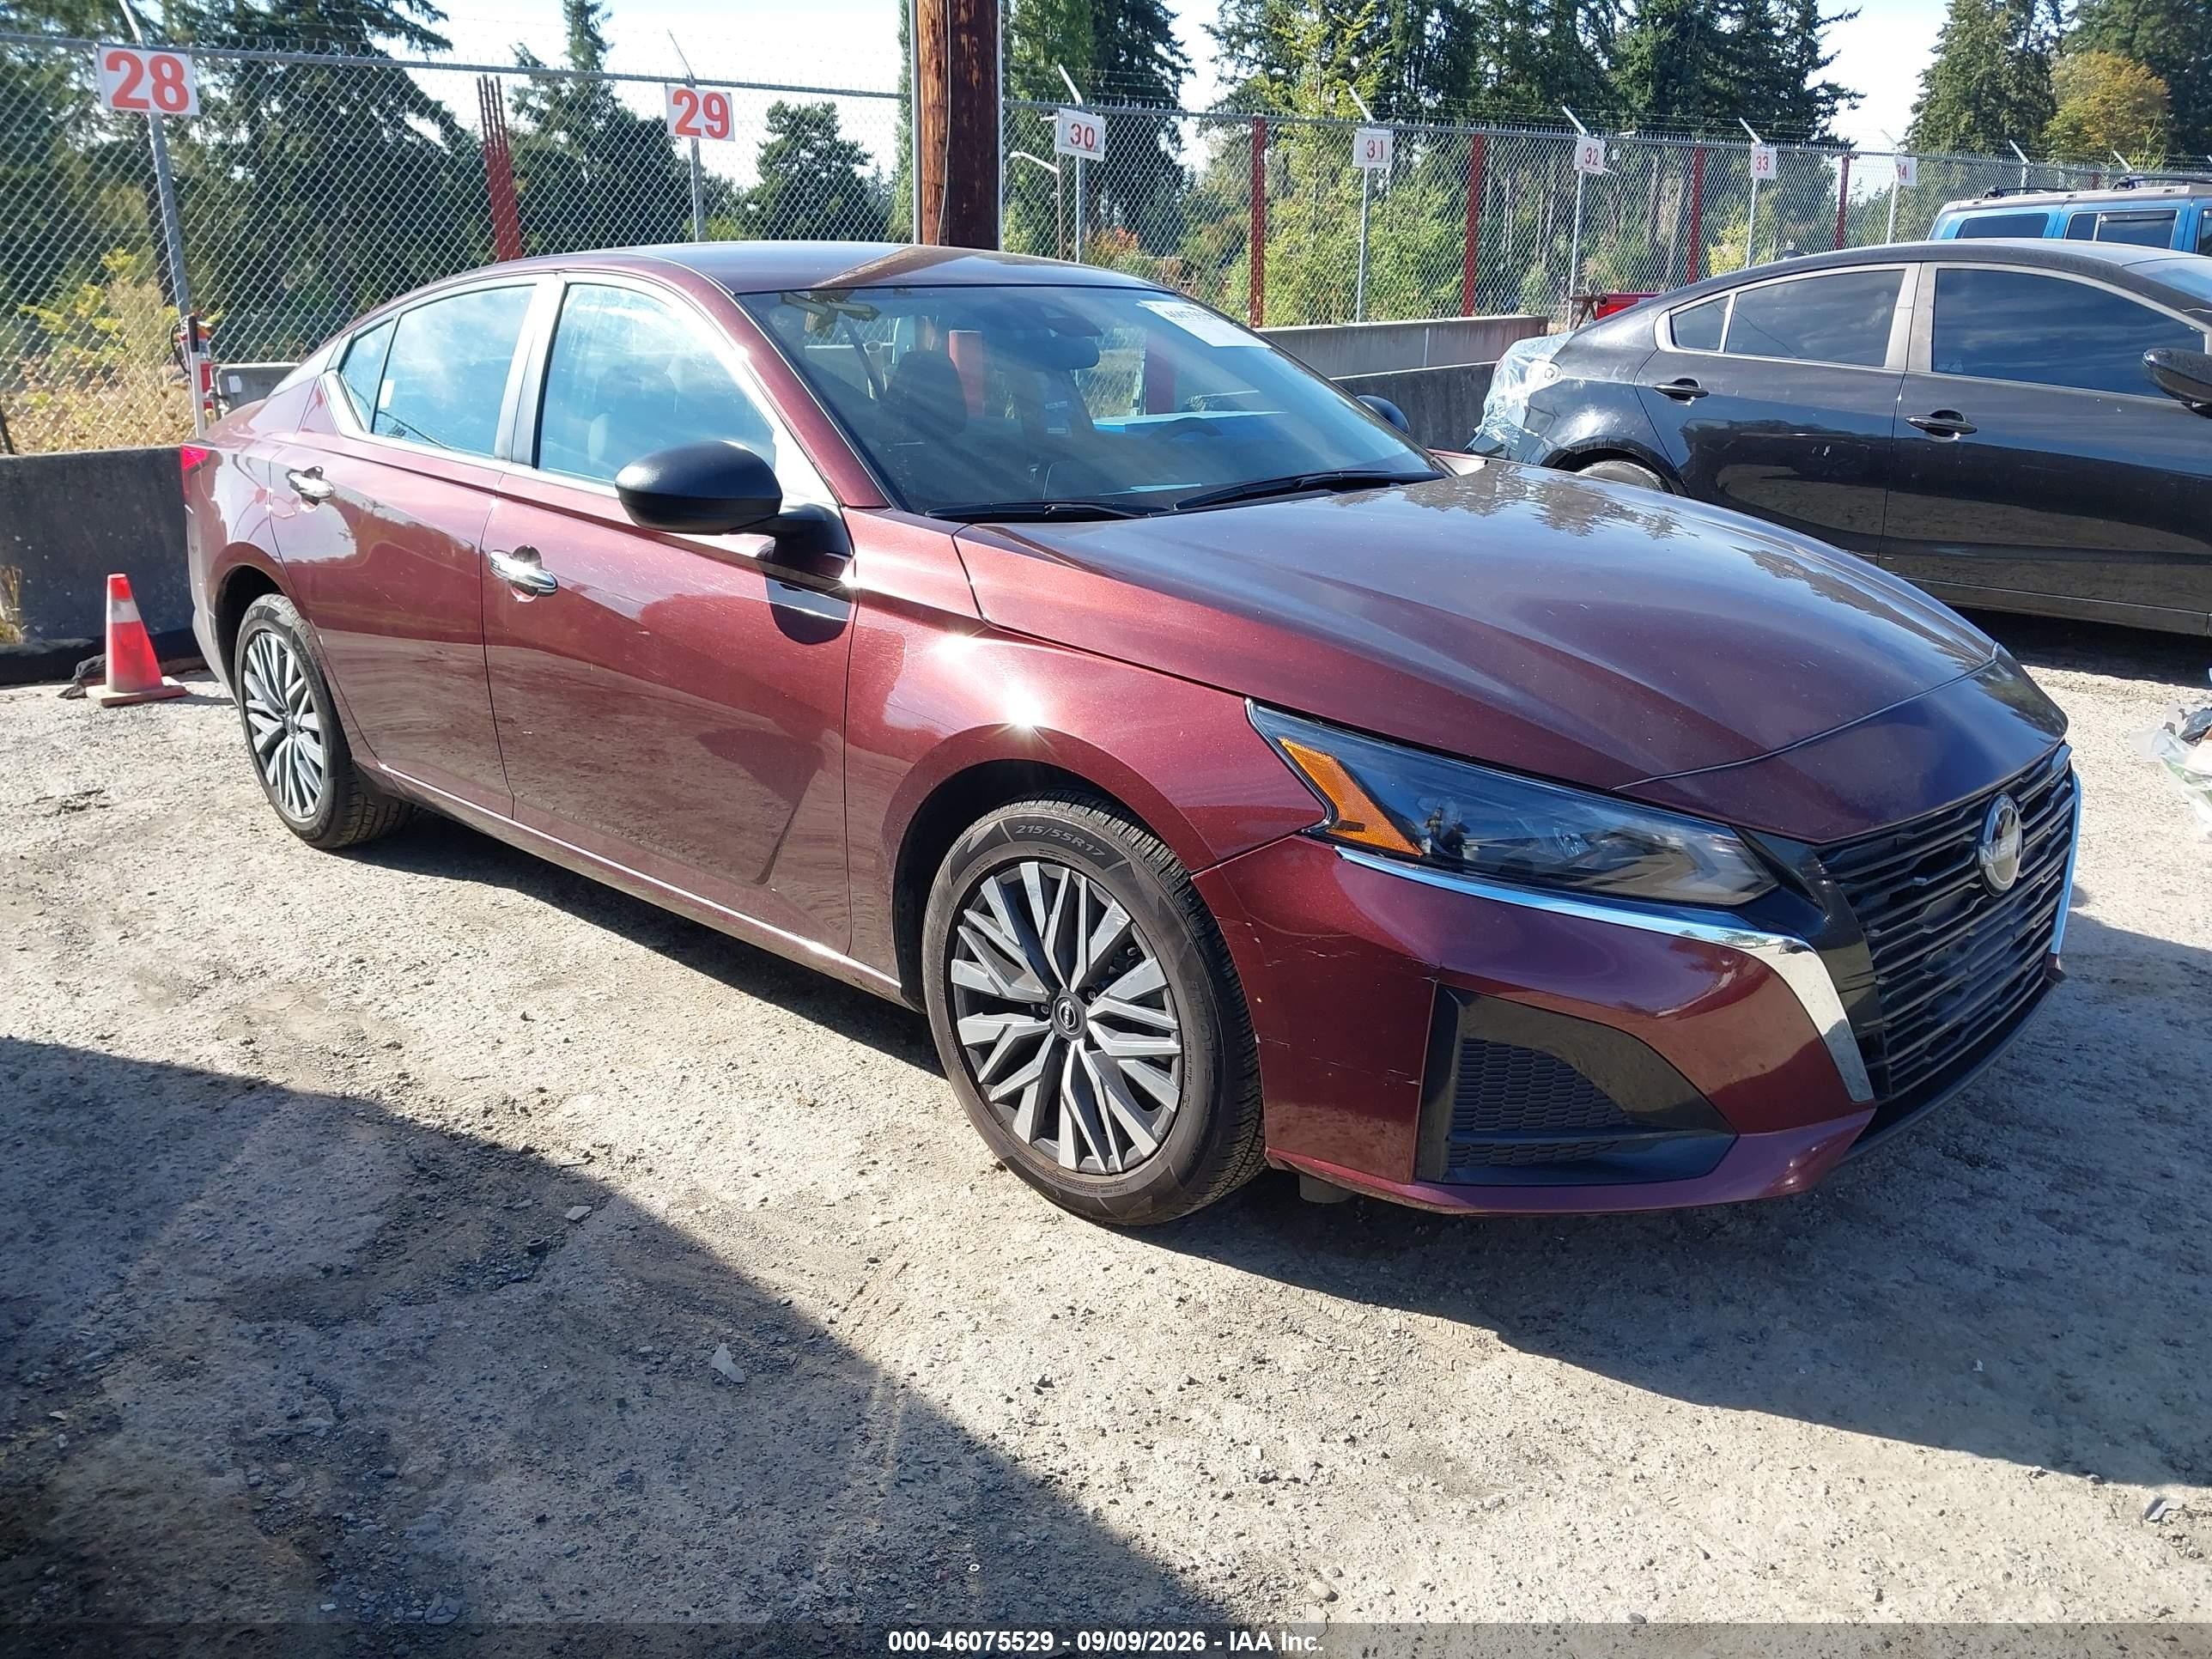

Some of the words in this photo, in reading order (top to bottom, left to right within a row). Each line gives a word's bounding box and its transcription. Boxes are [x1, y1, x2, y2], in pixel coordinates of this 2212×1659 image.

[105, 50, 190, 112] 28
[672, 88, 730, 140] 29
[1070, 123, 1095, 149] 30
[1366, 138, 1384, 160] 31
[1585, 146, 1599, 166] 32
[1756, 155, 1769, 171] 33
[1015, 824, 1107, 857] 215/55R17
[1981, 836, 2019, 863] NISS
